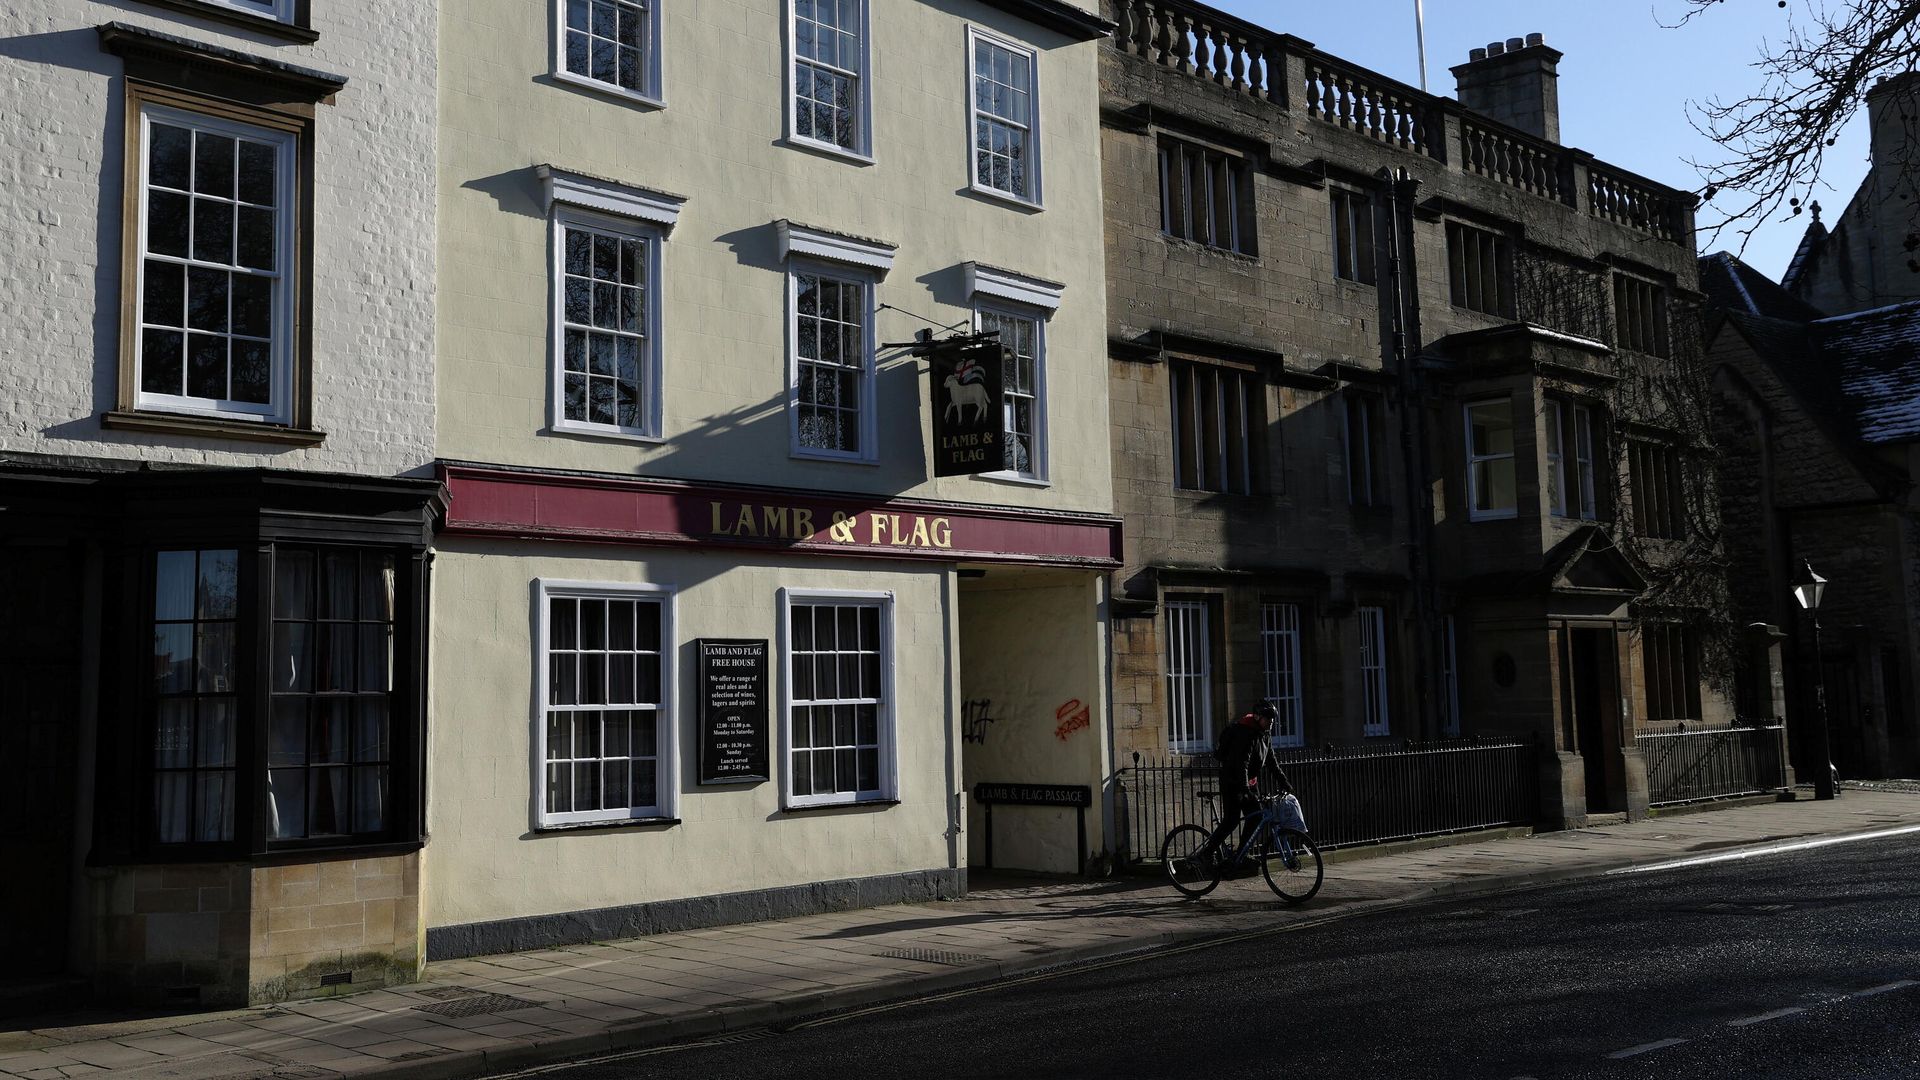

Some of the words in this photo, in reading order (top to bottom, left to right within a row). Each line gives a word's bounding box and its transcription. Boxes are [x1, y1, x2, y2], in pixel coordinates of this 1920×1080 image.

[943, 432, 978, 448] LAMB
[983, 431, 993, 443] &
[952, 449, 985, 463] FLAG
[710, 501, 815, 540] LAMB
[829, 510, 857, 543] &
[870, 513, 953, 548] FLAG
[705, 647, 726, 655] LAMB
[727, 647, 743, 655] AND
[743, 647, 762, 656] FLAG
[712, 658, 730, 667] FREE
[731, 658, 756, 667] HOUSE
[739, 699, 756, 707] spirits
[981, 787, 1008, 800] LAMB
[1009, 787, 1018, 800] &
[1021, 789, 1043, 801] FLAG
[1045, 790, 1083, 802] PASSAGE
